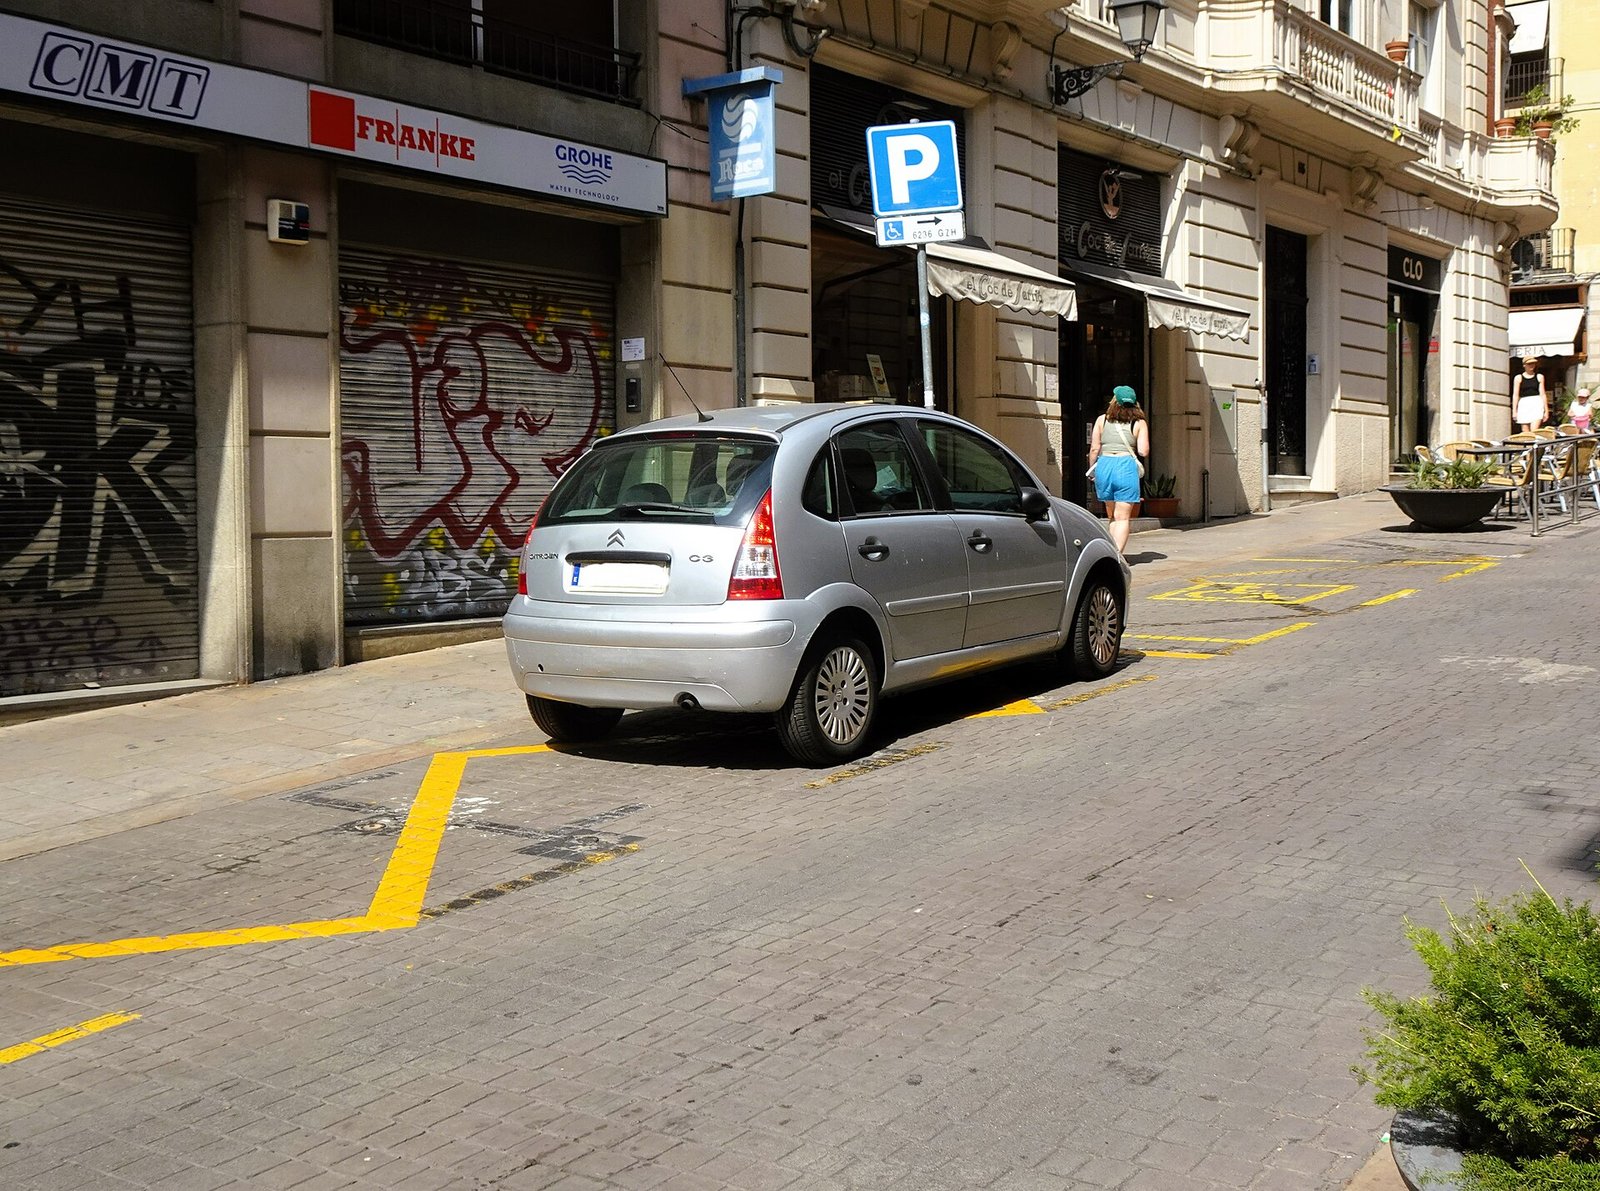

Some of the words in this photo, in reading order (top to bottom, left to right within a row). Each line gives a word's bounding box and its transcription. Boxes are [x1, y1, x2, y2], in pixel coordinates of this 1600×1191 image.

[42, 43, 203, 111] CMT
[356, 115, 475, 161] FRANKE
[555, 144, 613, 170] GROHE
[885, 134, 940, 205] P
[549, 184, 571, 193] WATER
[575, 188, 619, 202] TECHNOLOGY
[912, 230, 933, 239] 6236
[1402, 256, 1423, 281] CLO
[966, 276, 976, 292] el
[978, 273, 999, 300] Coc
[1001, 284, 1013, 298] de
[689, 554, 714, 563] C3
